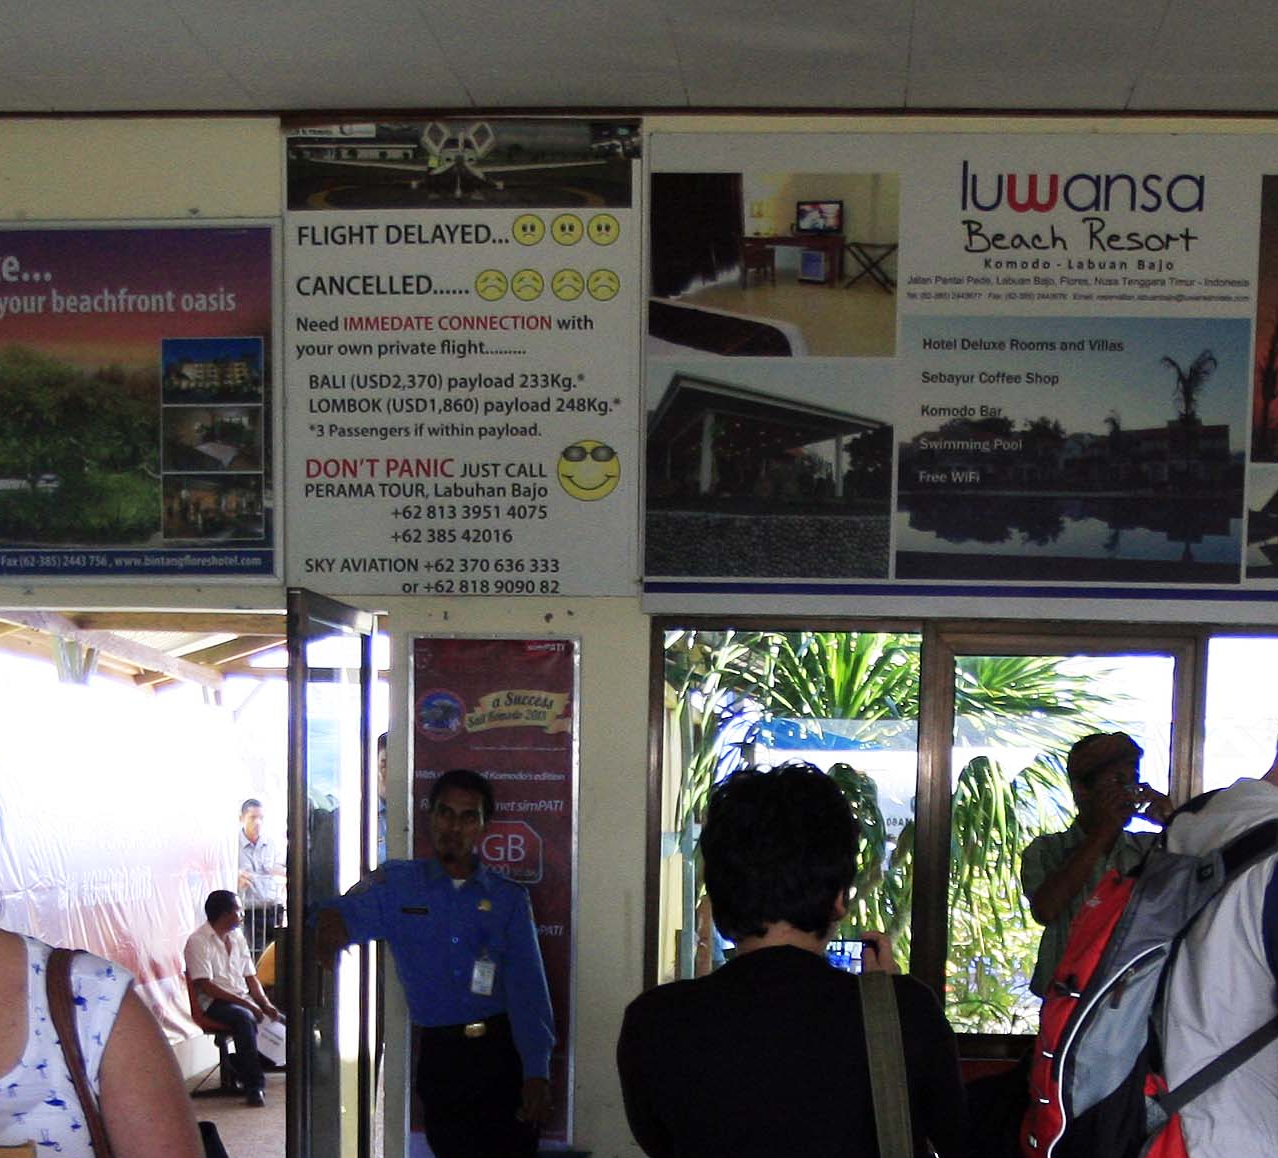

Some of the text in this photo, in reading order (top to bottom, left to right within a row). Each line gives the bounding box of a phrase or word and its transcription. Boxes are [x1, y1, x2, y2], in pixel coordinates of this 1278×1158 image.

[962, 160, 1205, 213] luwansa
[297, 225, 377, 246] FLIGHT
[961, 217, 1199, 253] Beach Resort
[984, 259, 1175, 272] Komodo Labuan Bajo
[1205, 278, 1250, 287] Indonesia
[51, 288, 175, 313] beachfront
[181, 288, 236, 313] oasis
[295, 314, 594, 332] Need IMMEDATE CONNECTION with
[295, 342, 334, 362] your
[338, 342, 375, 356] own
[377, 339, 437, 359] private
[922, 338, 1125, 352] Hotel Deluxe Rooms and Villas
[309, 374, 346, 390] BALI
[350, 373, 444, 393] (USD2,370)
[447, 373, 515, 394] payload
[921, 372, 1059, 387] Sebayur Coffee Shop
[309, 398, 382, 414] LOMBOK
[386, 397, 480, 416] (USD1,860)
[483, 397, 552, 416] payload
[921, 404, 1003, 417] Komodo Bar
[328, 423, 411, 441] Passengers
[414, 423, 424, 437] if
[426, 423, 474, 437] within
[477, 423, 542, 440] payload.
[919, 438, 1022, 452] Swimming Pool
[385, 457, 455, 479] PANIC
[459, 462, 502, 478] JUST
[505, 462, 548, 478] CALL
[918, 470, 948, 483] Free
[304, 482, 549, 501] PERAMA TOUR, Labuhan Bajo
[390, 505, 548, 521] +62 813 3951 4075
[390, 528, 513, 544] +62 385 42016
[1, 555, 19, 569] Fax
[304, 558, 560, 573] SKY AVIATION +62 370 636 333
[402, 579, 560, 594] or +62 818 9090 82
[504, 691, 555, 710] Success
[481, 833, 526, 862] GB
